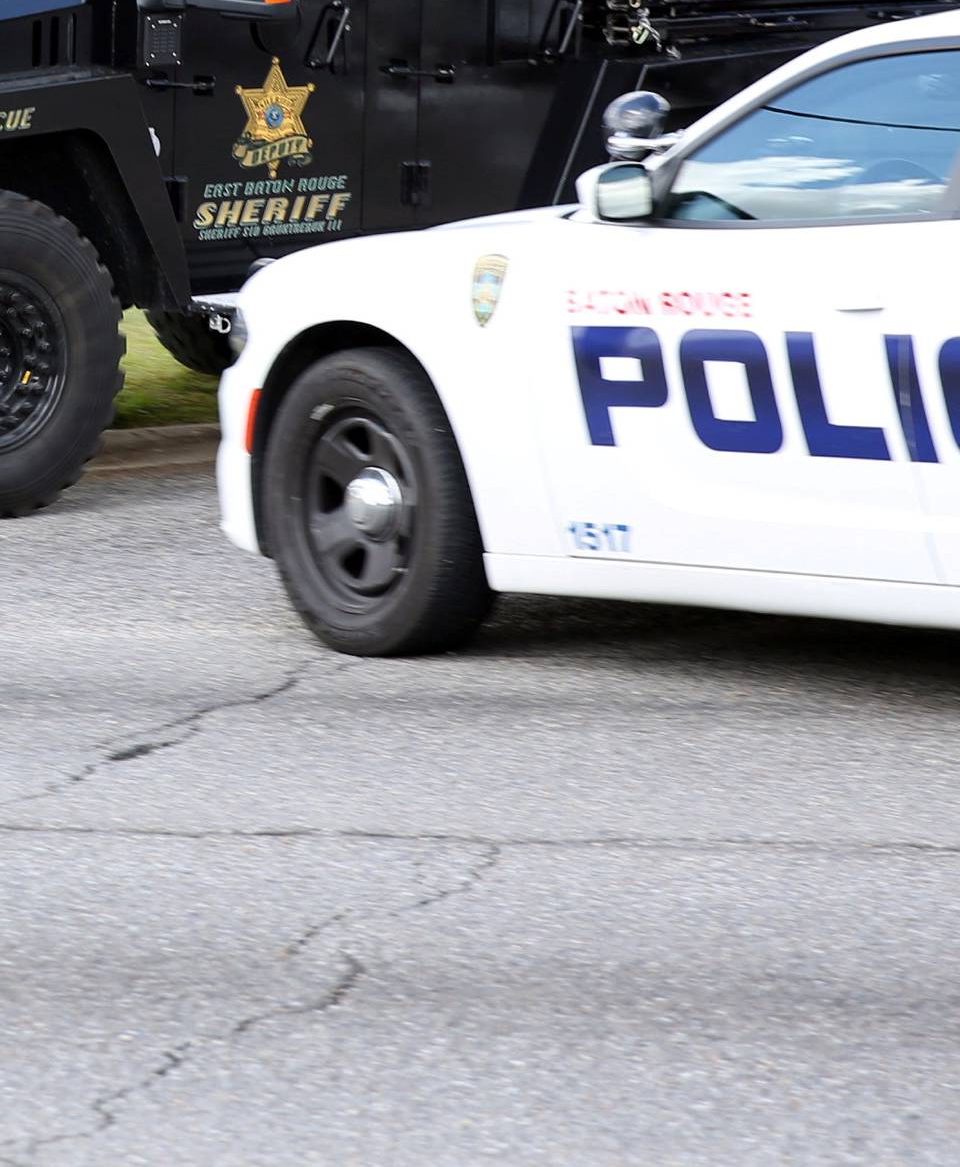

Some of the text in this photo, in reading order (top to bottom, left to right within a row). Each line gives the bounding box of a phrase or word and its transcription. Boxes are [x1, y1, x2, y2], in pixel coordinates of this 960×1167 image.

[251, 137, 305, 164] DEPUTY
[203, 175, 348, 199] EAST BATON ROUGE
[193, 192, 352, 230] SHERIFF
[198, 227, 241, 241] SHERIFF
[659, 290, 753, 319] ROUGE
[570, 324, 960, 464] POLI
[565, 520, 632, 553] 1517
